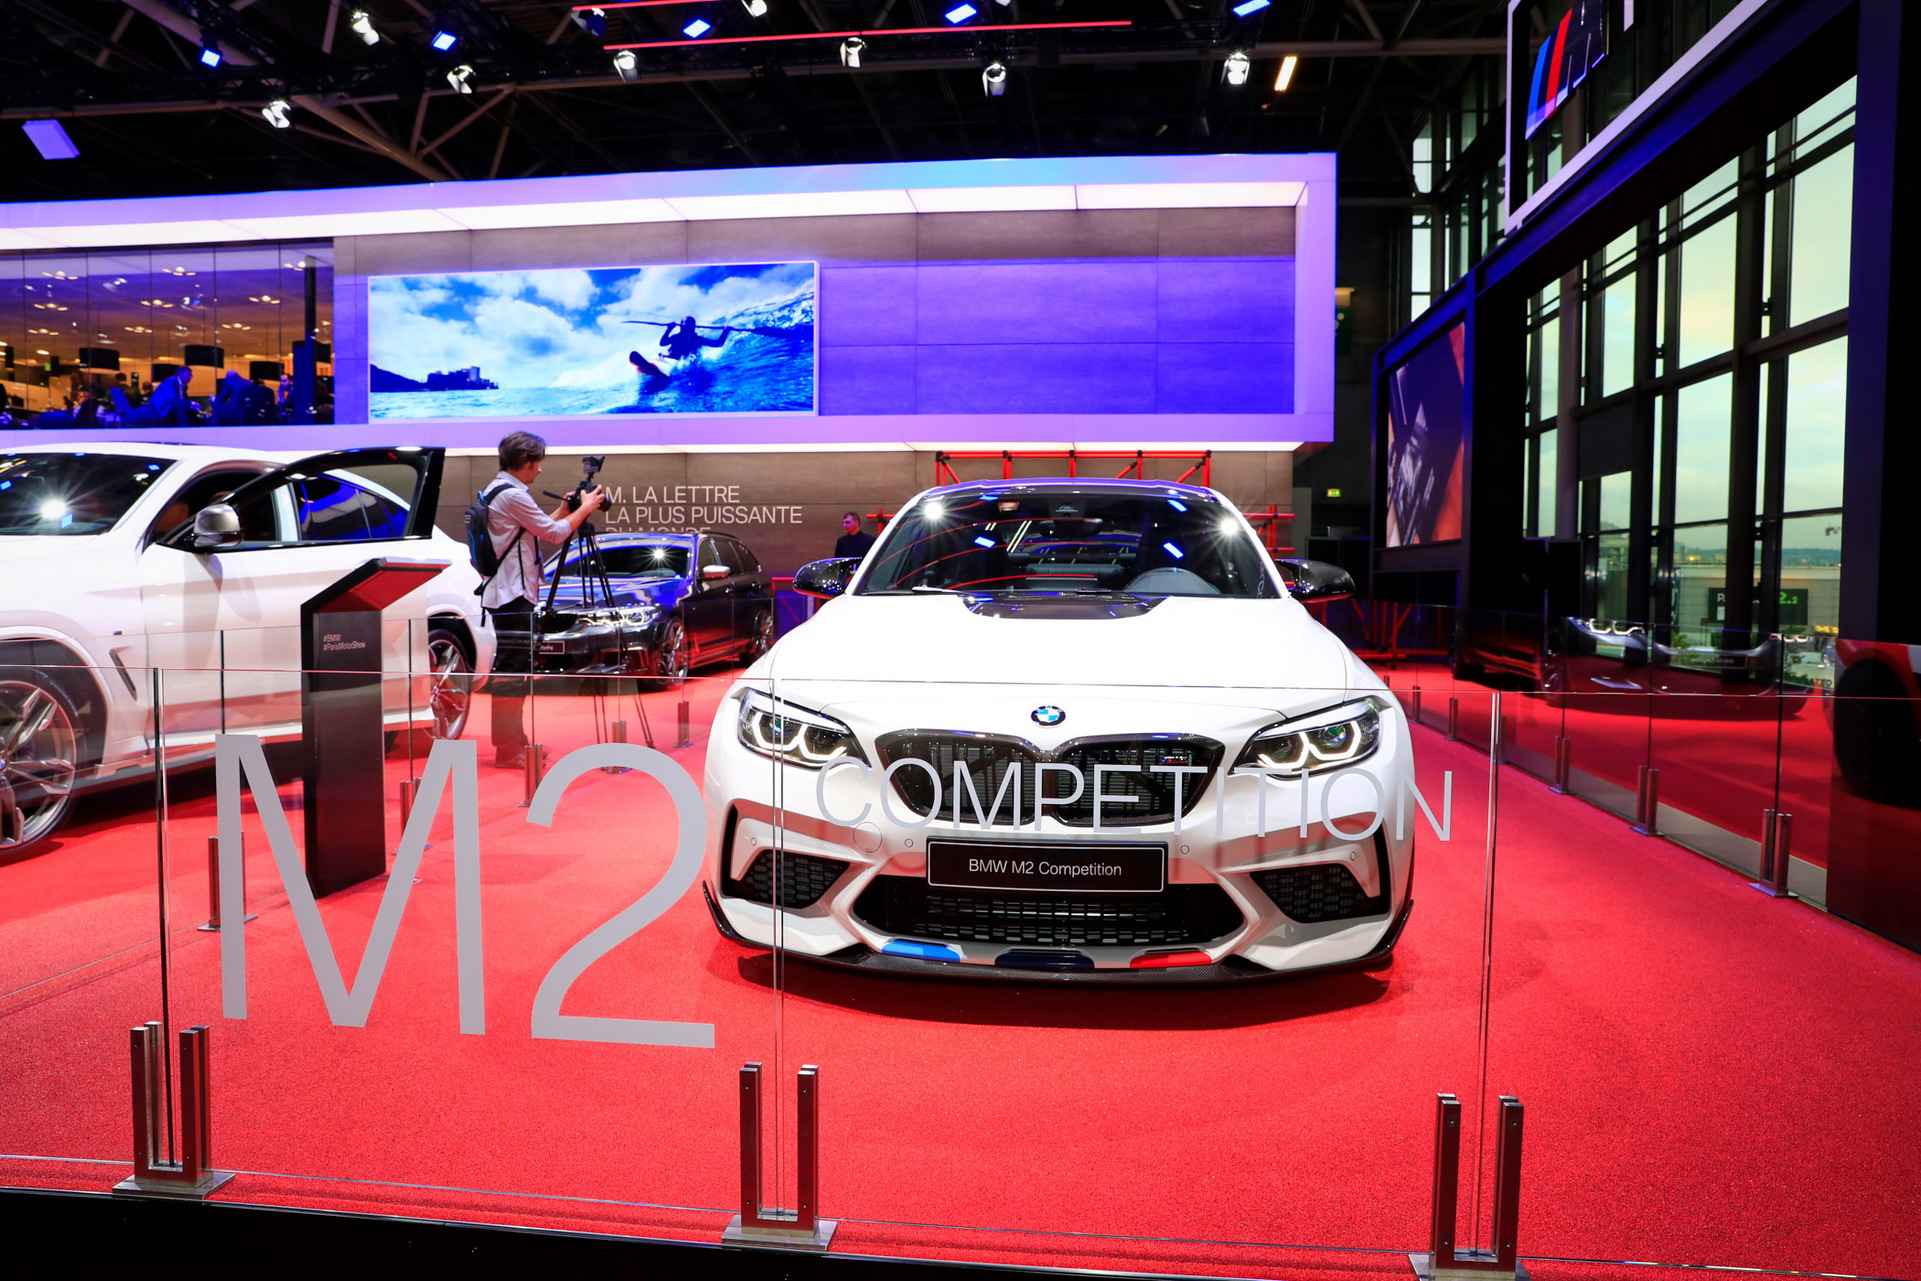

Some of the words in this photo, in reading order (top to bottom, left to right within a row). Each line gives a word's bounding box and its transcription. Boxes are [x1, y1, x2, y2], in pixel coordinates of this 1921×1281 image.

[605, 486, 626, 503] M.
[632, 486, 658, 503] LA
[663, 486, 740, 503] LETTRE
[605, 507, 630, 524] LA
[636, 507, 685, 524] PLUS
[692, 506, 803, 524] PUISSANTE
[969, 859, 1008, 873] BMW
[1012, 861, 1034, 874] M2
[1039, 862, 1122, 878] Competition
[215, 734, 715, 1049] M2
[815, 755, 1453, 842] COMPETITION
